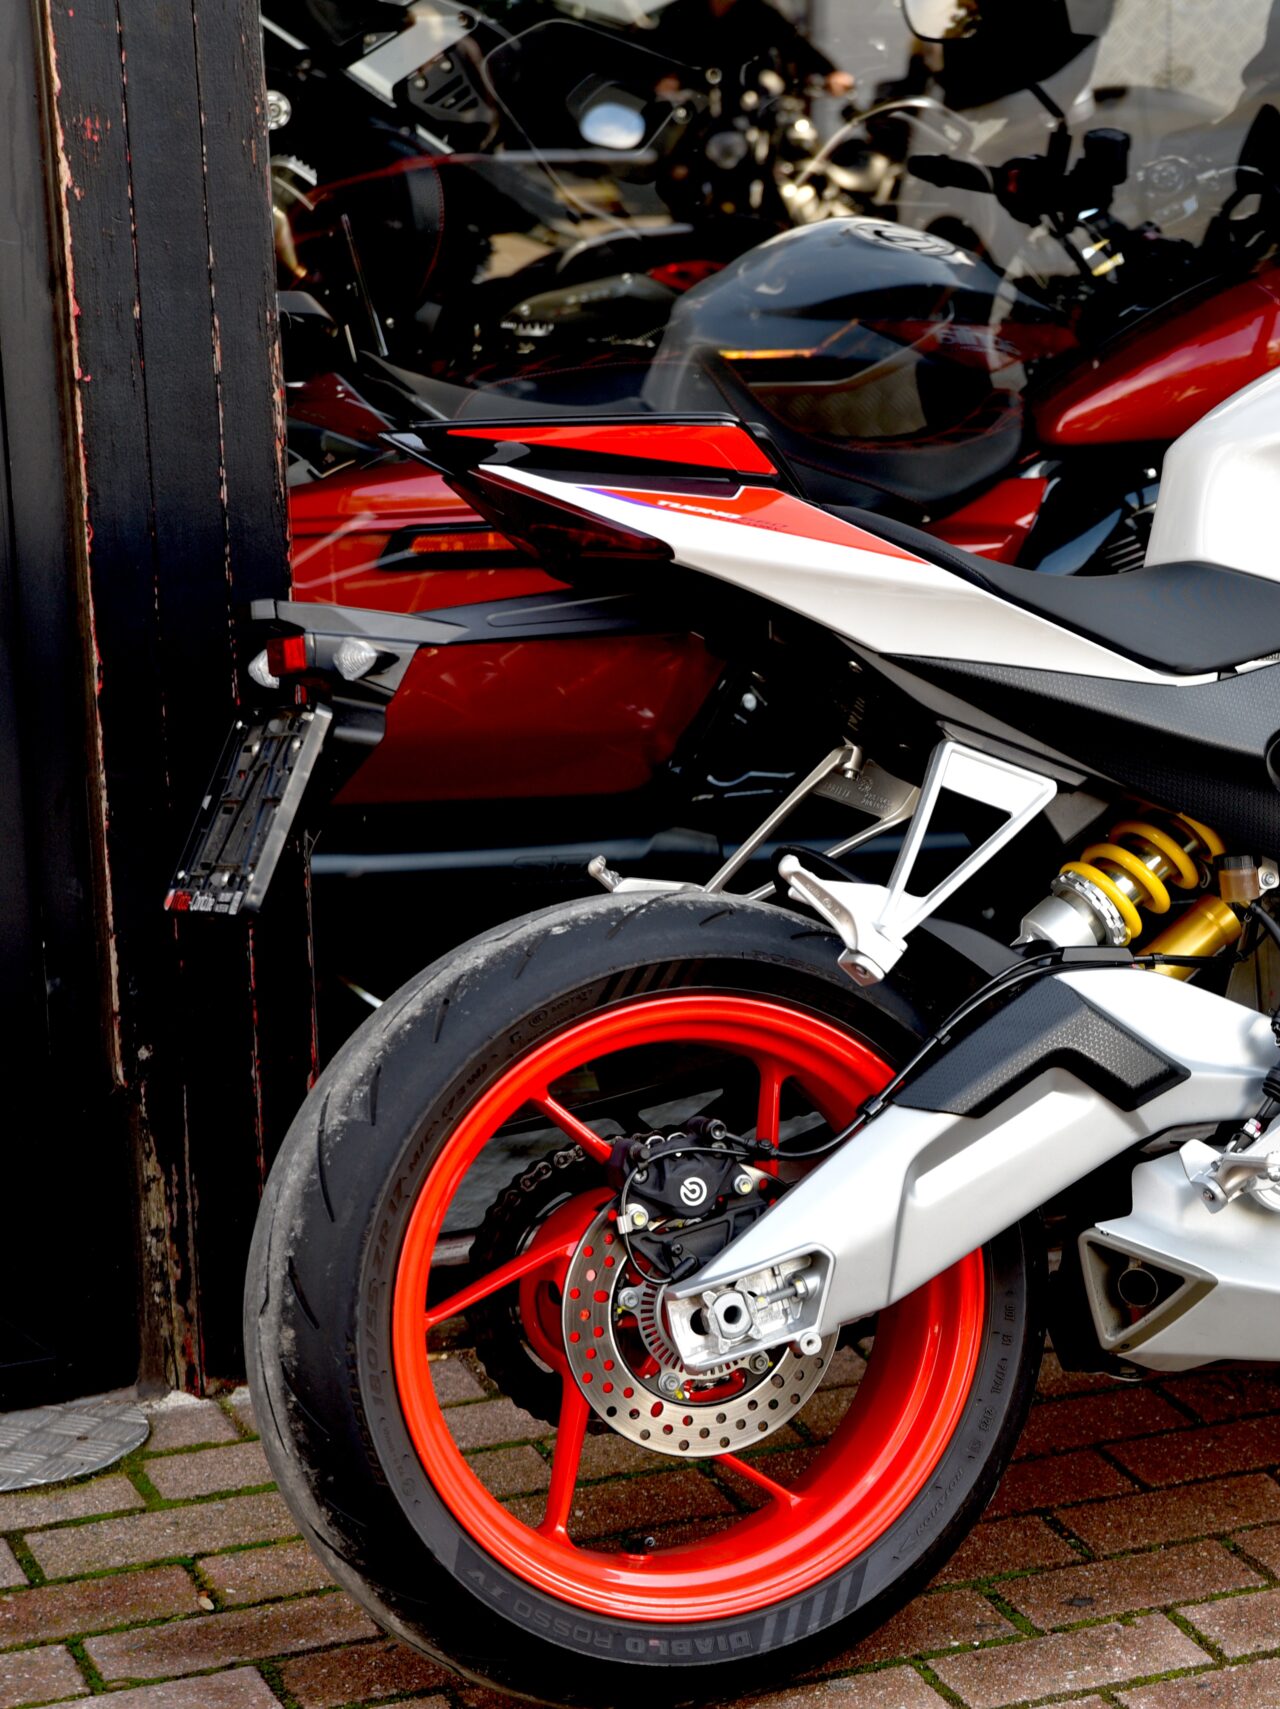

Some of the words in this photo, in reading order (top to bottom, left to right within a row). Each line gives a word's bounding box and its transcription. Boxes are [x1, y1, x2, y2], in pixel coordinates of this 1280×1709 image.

[465, 1569, 511, 1602] IV
[511, 1598, 613, 1650] ROSSO
[626, 1628, 751, 1656] DIABLO
